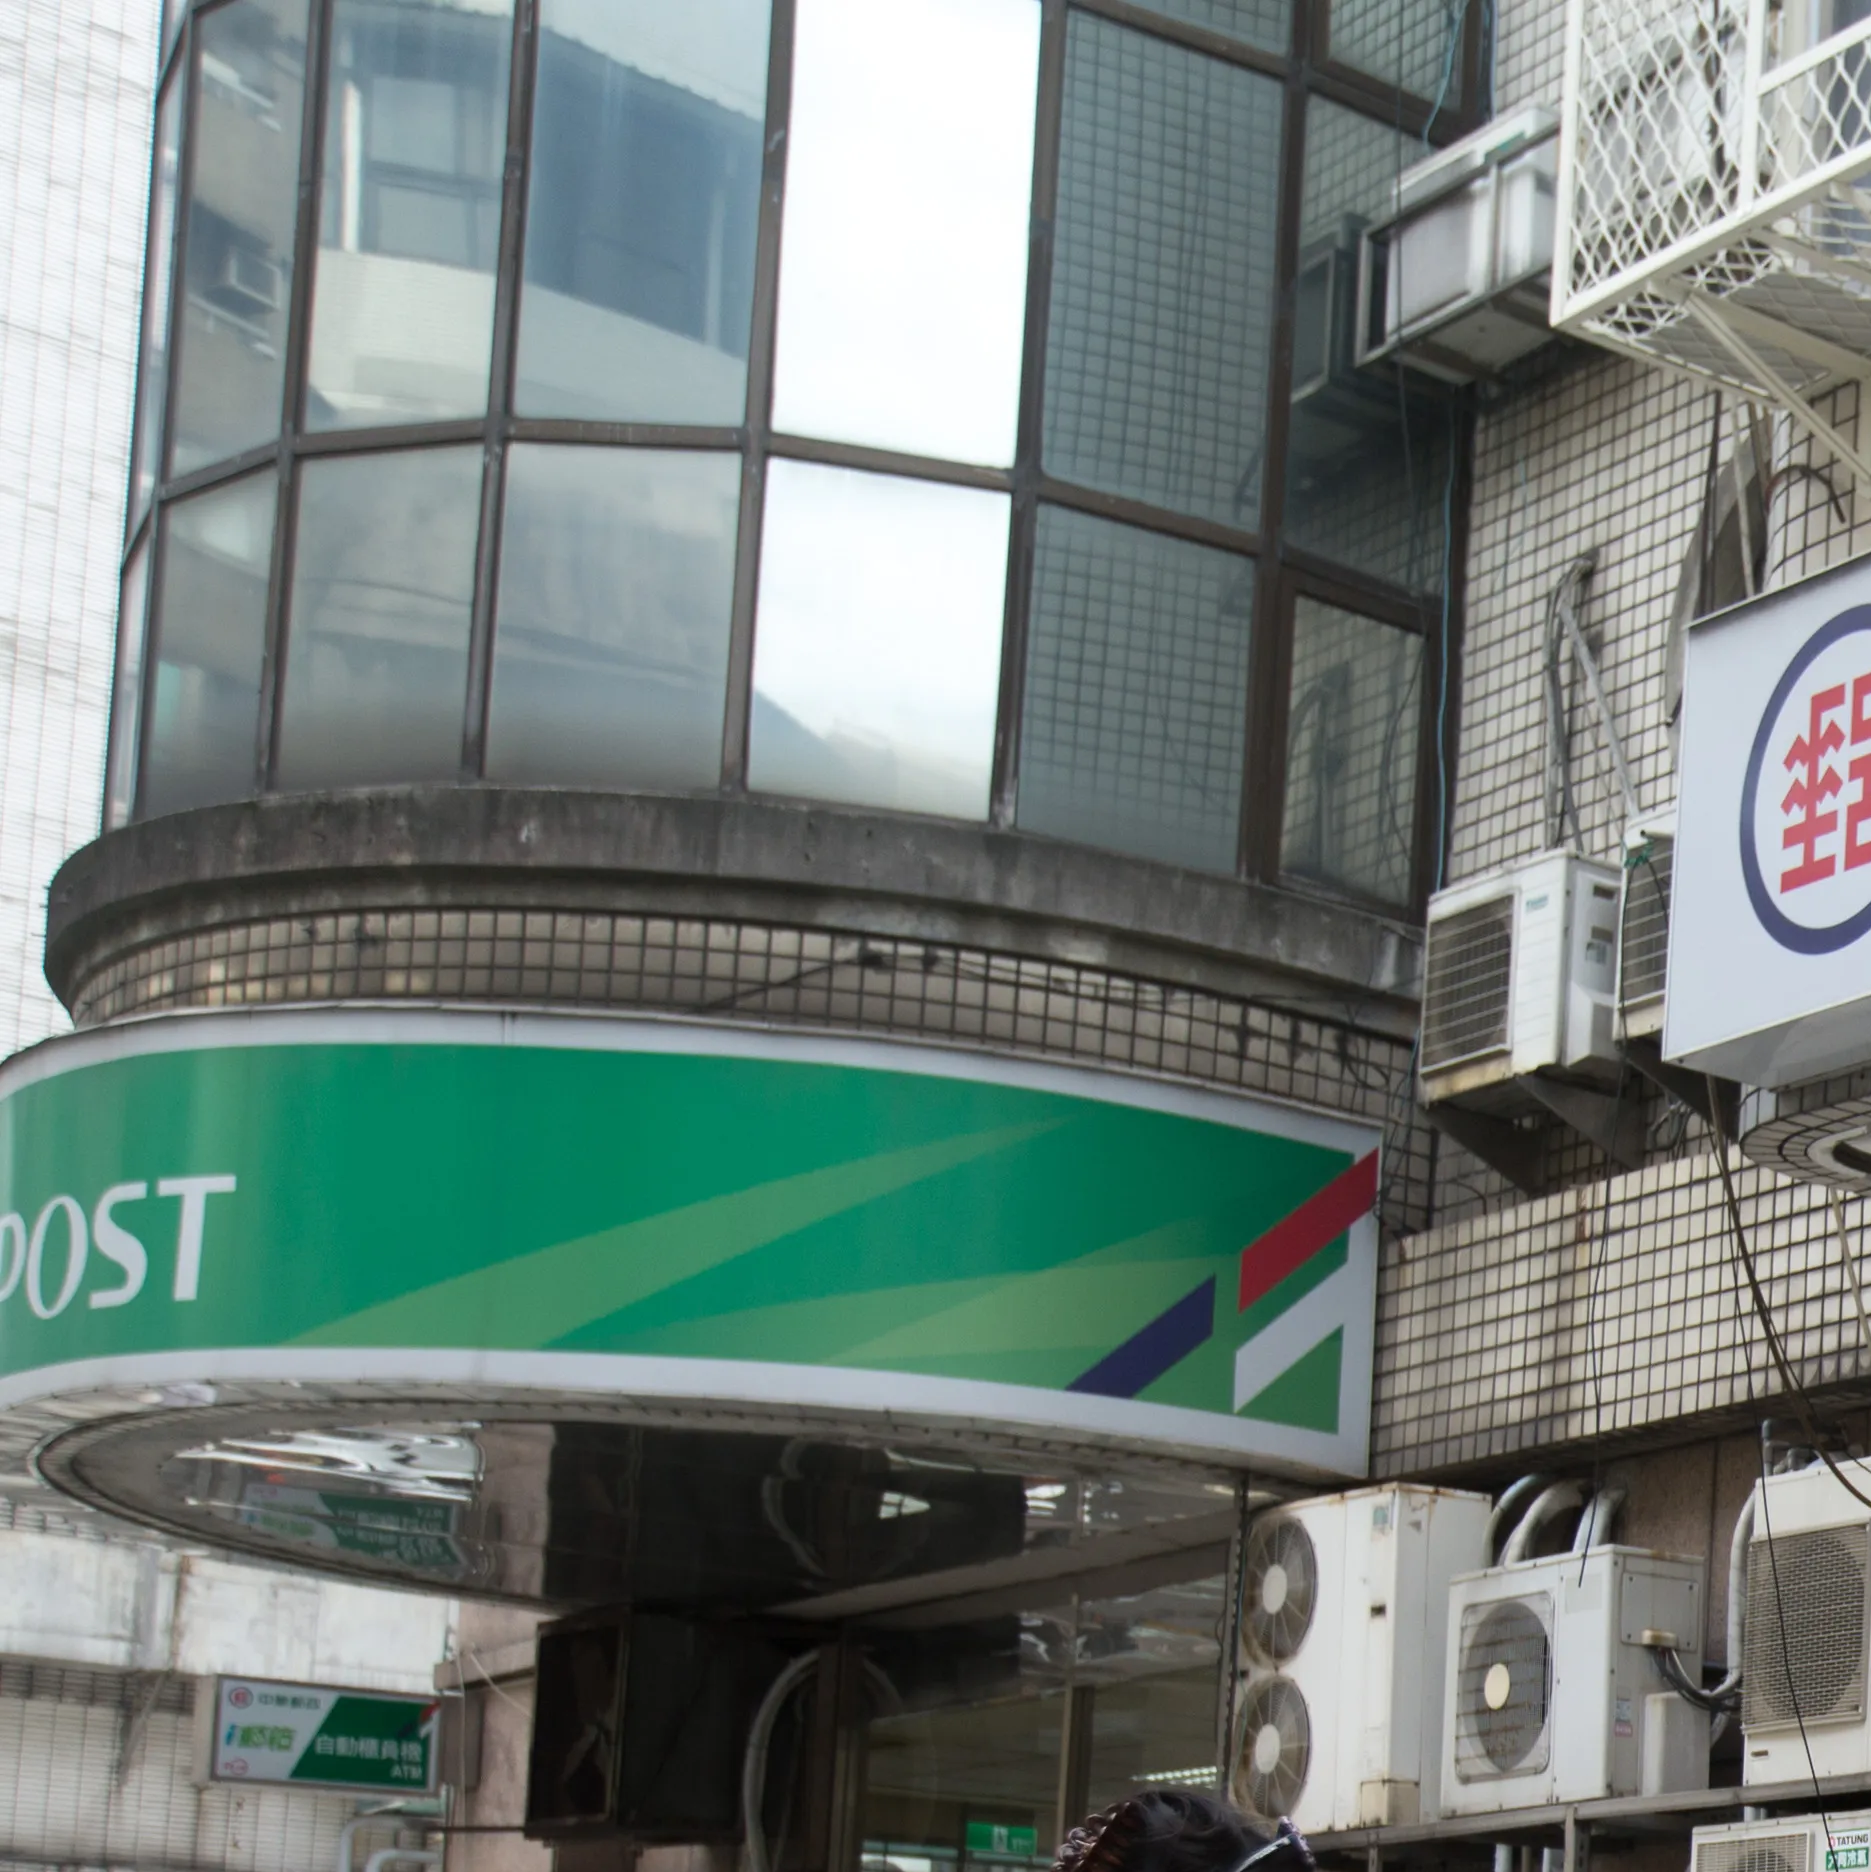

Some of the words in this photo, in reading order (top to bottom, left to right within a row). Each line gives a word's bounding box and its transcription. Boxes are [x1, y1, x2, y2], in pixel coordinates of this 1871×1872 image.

[315, 1735, 423, 1762] 自動櫃員機
[391, 1765, 422, 1779] ATM
[1837, 1834, 1869, 1846] TATUNG
